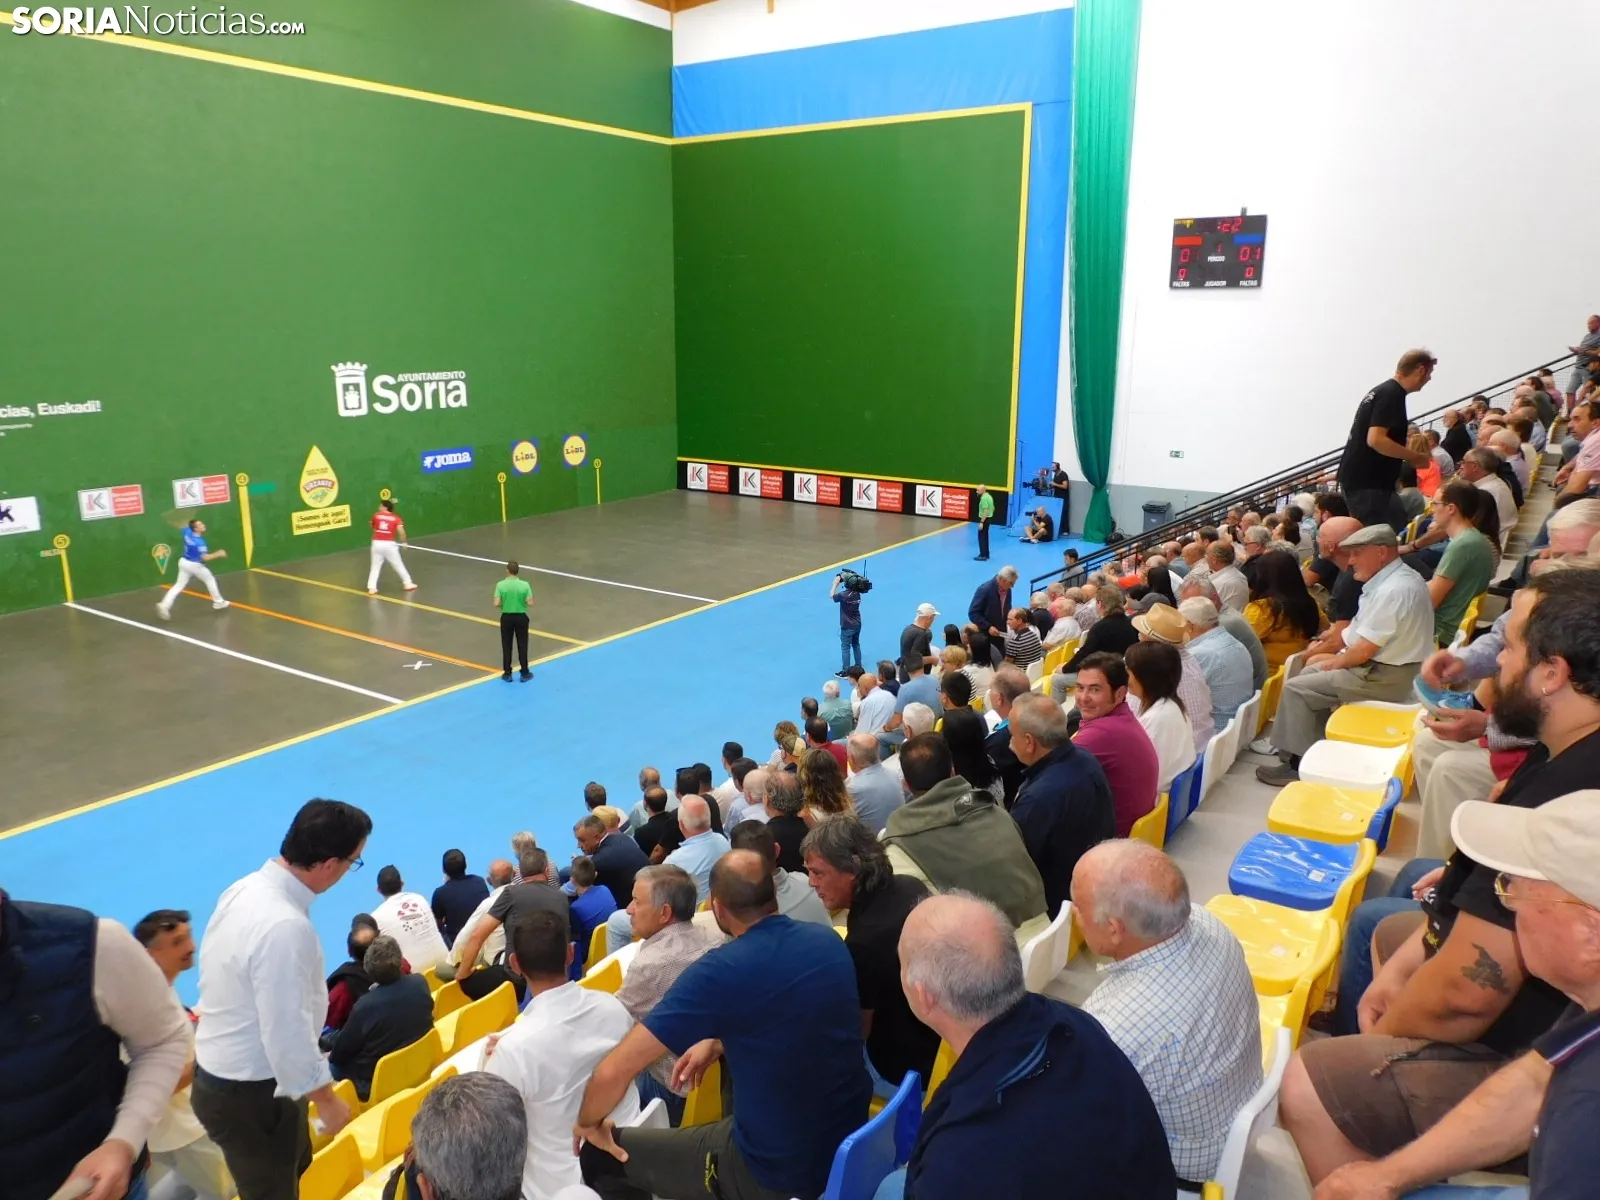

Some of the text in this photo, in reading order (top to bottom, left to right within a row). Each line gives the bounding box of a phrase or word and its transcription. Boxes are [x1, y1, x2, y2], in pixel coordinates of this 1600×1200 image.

[397, 370, 466, 382] AYUNTAMIENTO
[372, 374, 468, 414] Soria
[37, 400, 102, 416] Euskadi!
